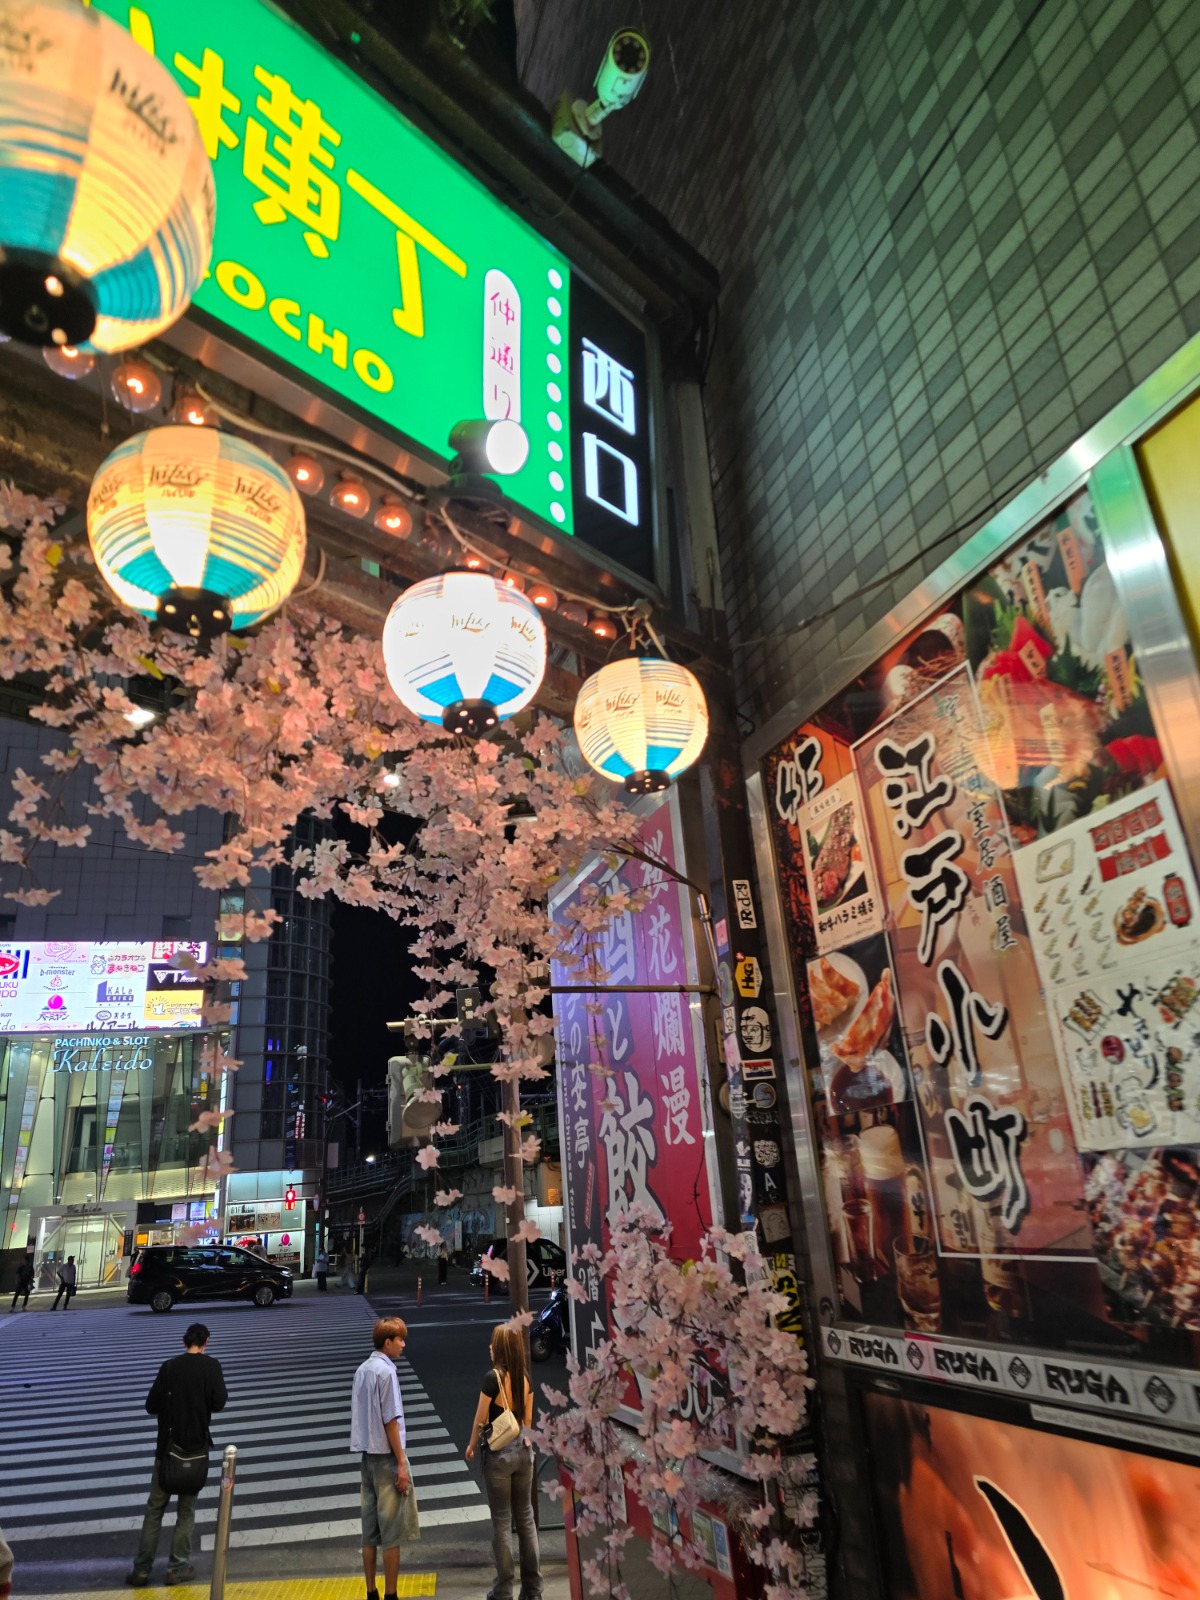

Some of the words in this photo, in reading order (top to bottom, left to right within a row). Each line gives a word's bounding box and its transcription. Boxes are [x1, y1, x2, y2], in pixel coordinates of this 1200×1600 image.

[582, 337, 639, 527] 西口
[876, 734, 1025, 1230] 江戸小町
[47, 1047, 153, 1075] Kaleido
[55, 1037, 111, 1047] PACHINKO
[113, 1037, 121, 1045] &
[123, 1036, 150, 1046] SLOT
[562, 1082, 570, 1108] and
[565, 1113, 574, 1182] Chinese
[568, 1187, 577, 1231] food
[848, 1334, 900, 1366] RUGA
[932, 1346, 999, 1383] RUGA
[1043, 1362, 1131, 1406] RUGA
